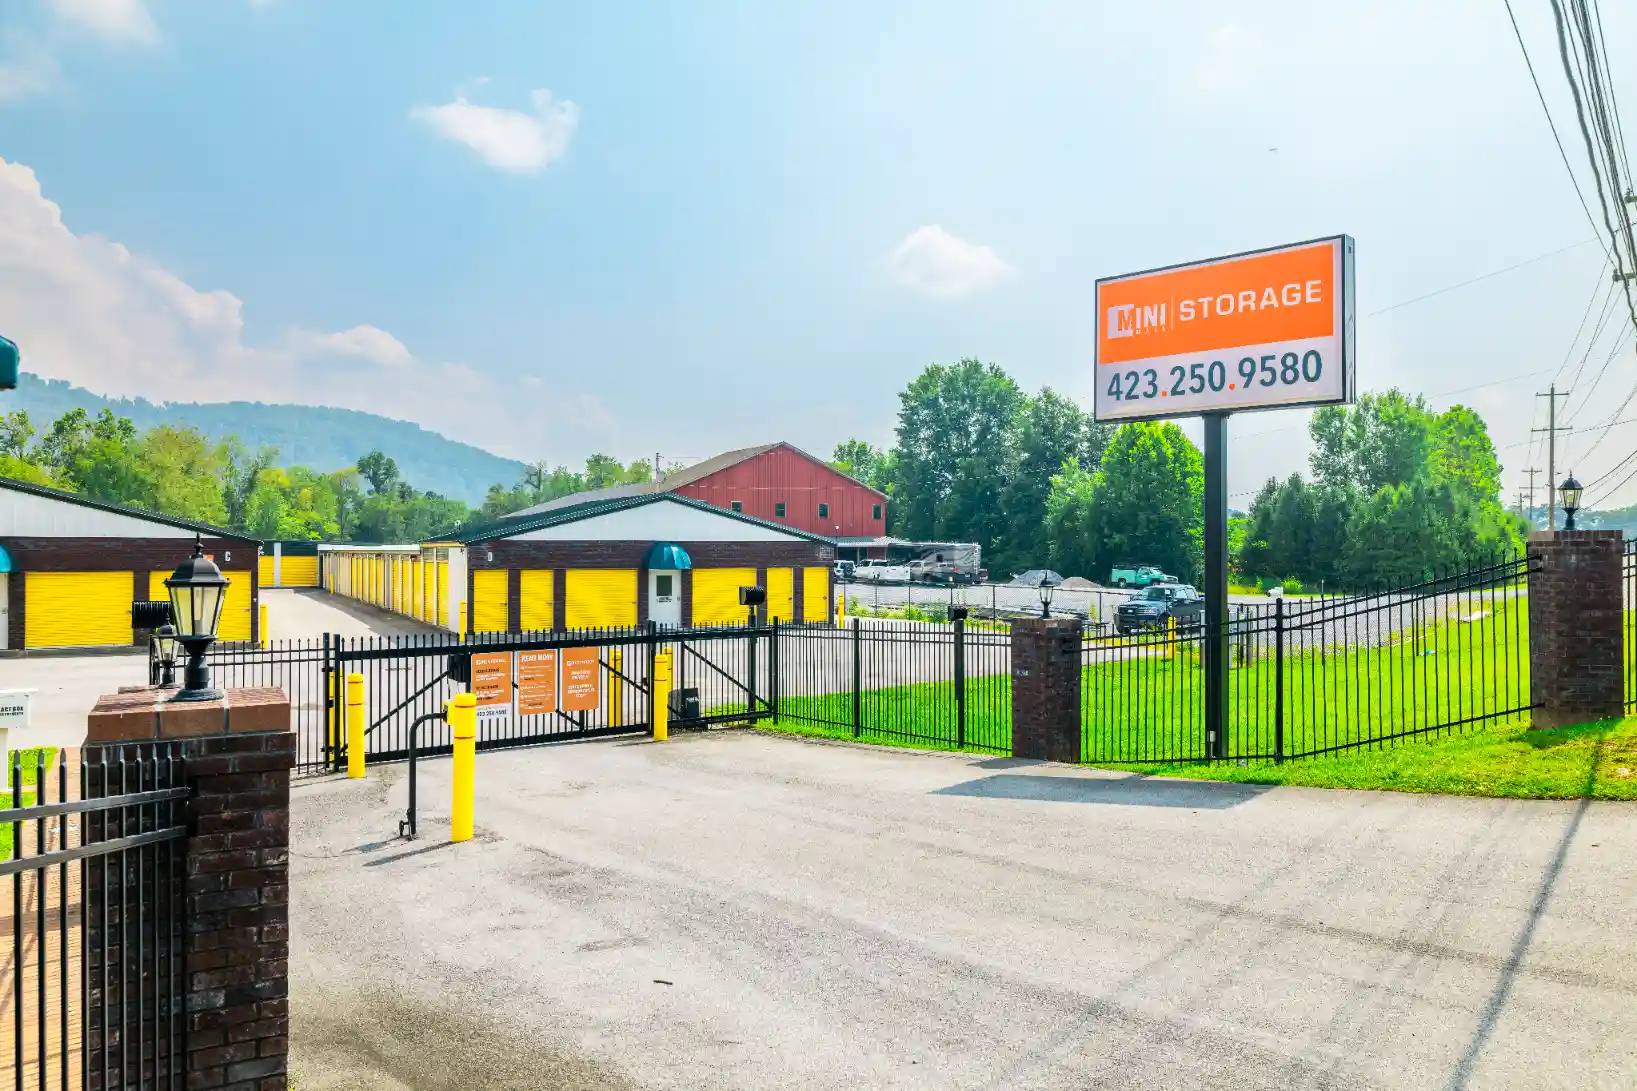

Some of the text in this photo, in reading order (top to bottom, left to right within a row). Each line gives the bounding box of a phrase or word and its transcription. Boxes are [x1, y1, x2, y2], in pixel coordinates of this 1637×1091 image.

[1107, 279, 1322, 338] MINI STORAGE
[1107, 349, 1323, 401] 423.250.9580
